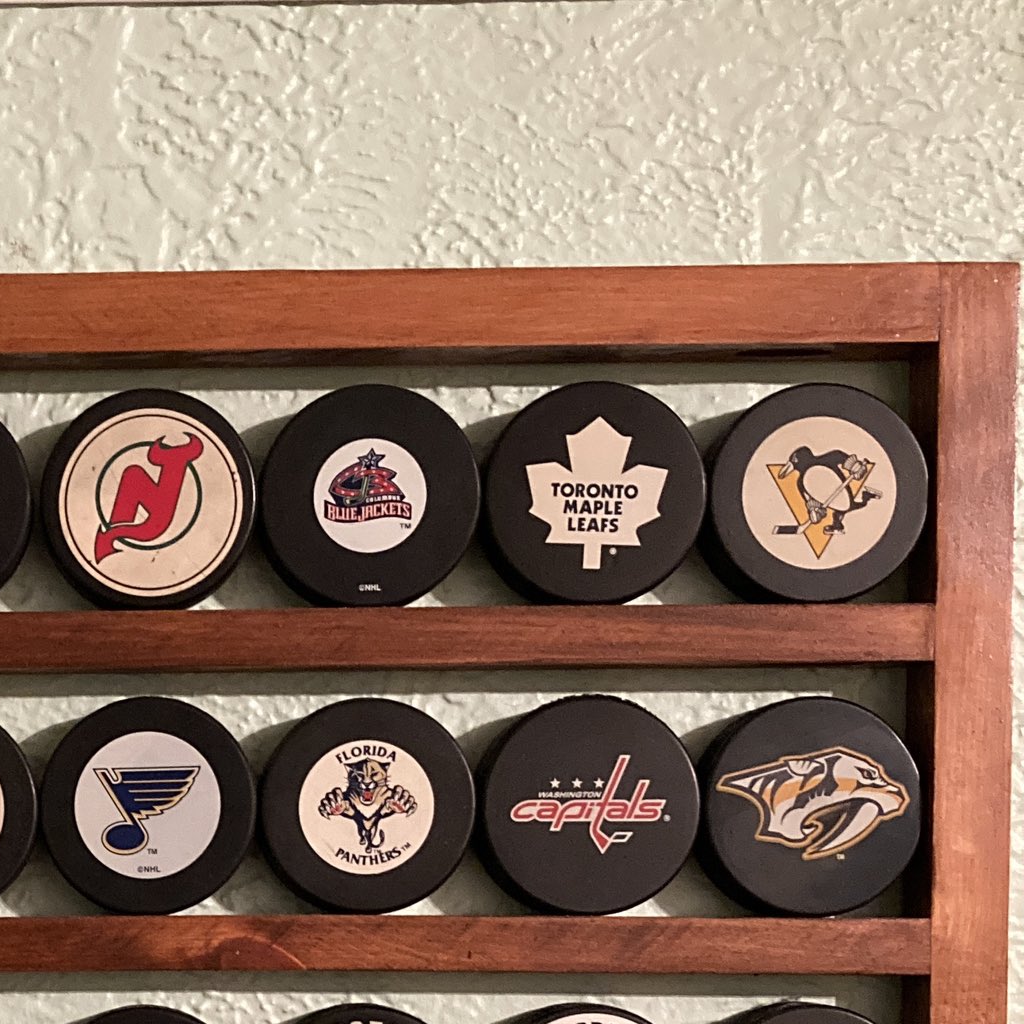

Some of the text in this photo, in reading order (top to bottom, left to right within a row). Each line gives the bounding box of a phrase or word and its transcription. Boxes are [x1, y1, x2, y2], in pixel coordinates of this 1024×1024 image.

[551, 482, 638, 499] TORONTO
[327, 504, 411, 522] BLUE JACKETS
[563, 500, 623, 515] MAPLE
[567, 517, 619, 533] LEAFS
[335, 745, 397, 764] FLORIDA
[511, 755, 667, 854] capitals
[334, 846, 402, 866] PANTHERS
